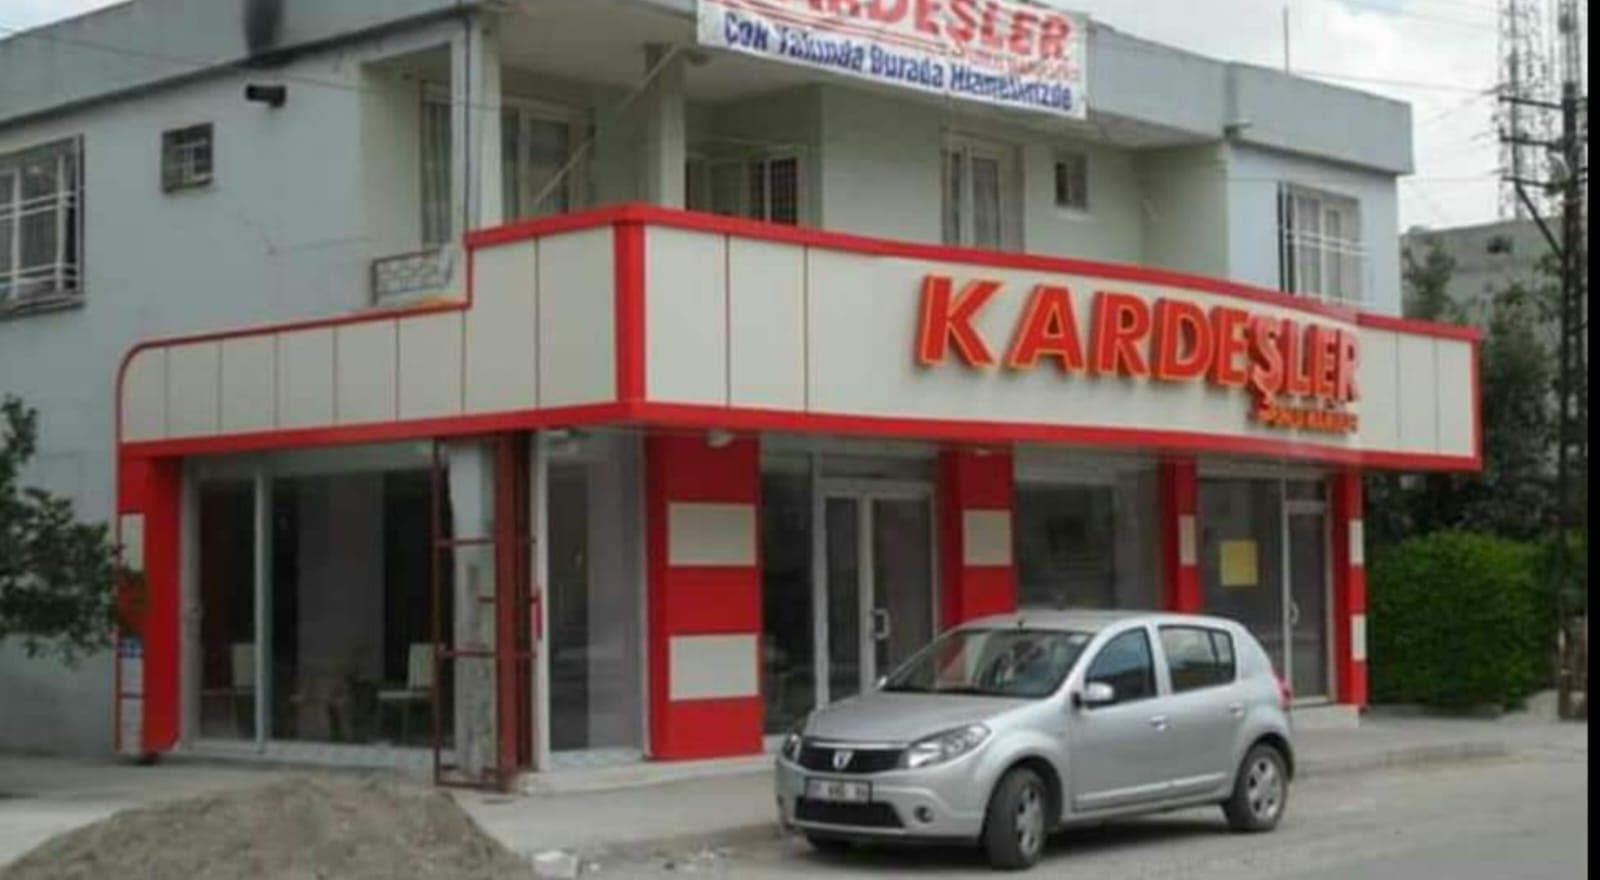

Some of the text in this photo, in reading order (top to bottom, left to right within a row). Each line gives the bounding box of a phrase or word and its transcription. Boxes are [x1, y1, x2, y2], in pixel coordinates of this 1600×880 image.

[806, 0, 1071, 60] DEŞLER
[870, 43, 944, 89] Burada
[917, 273, 1360, 404] KARDEŞLER
